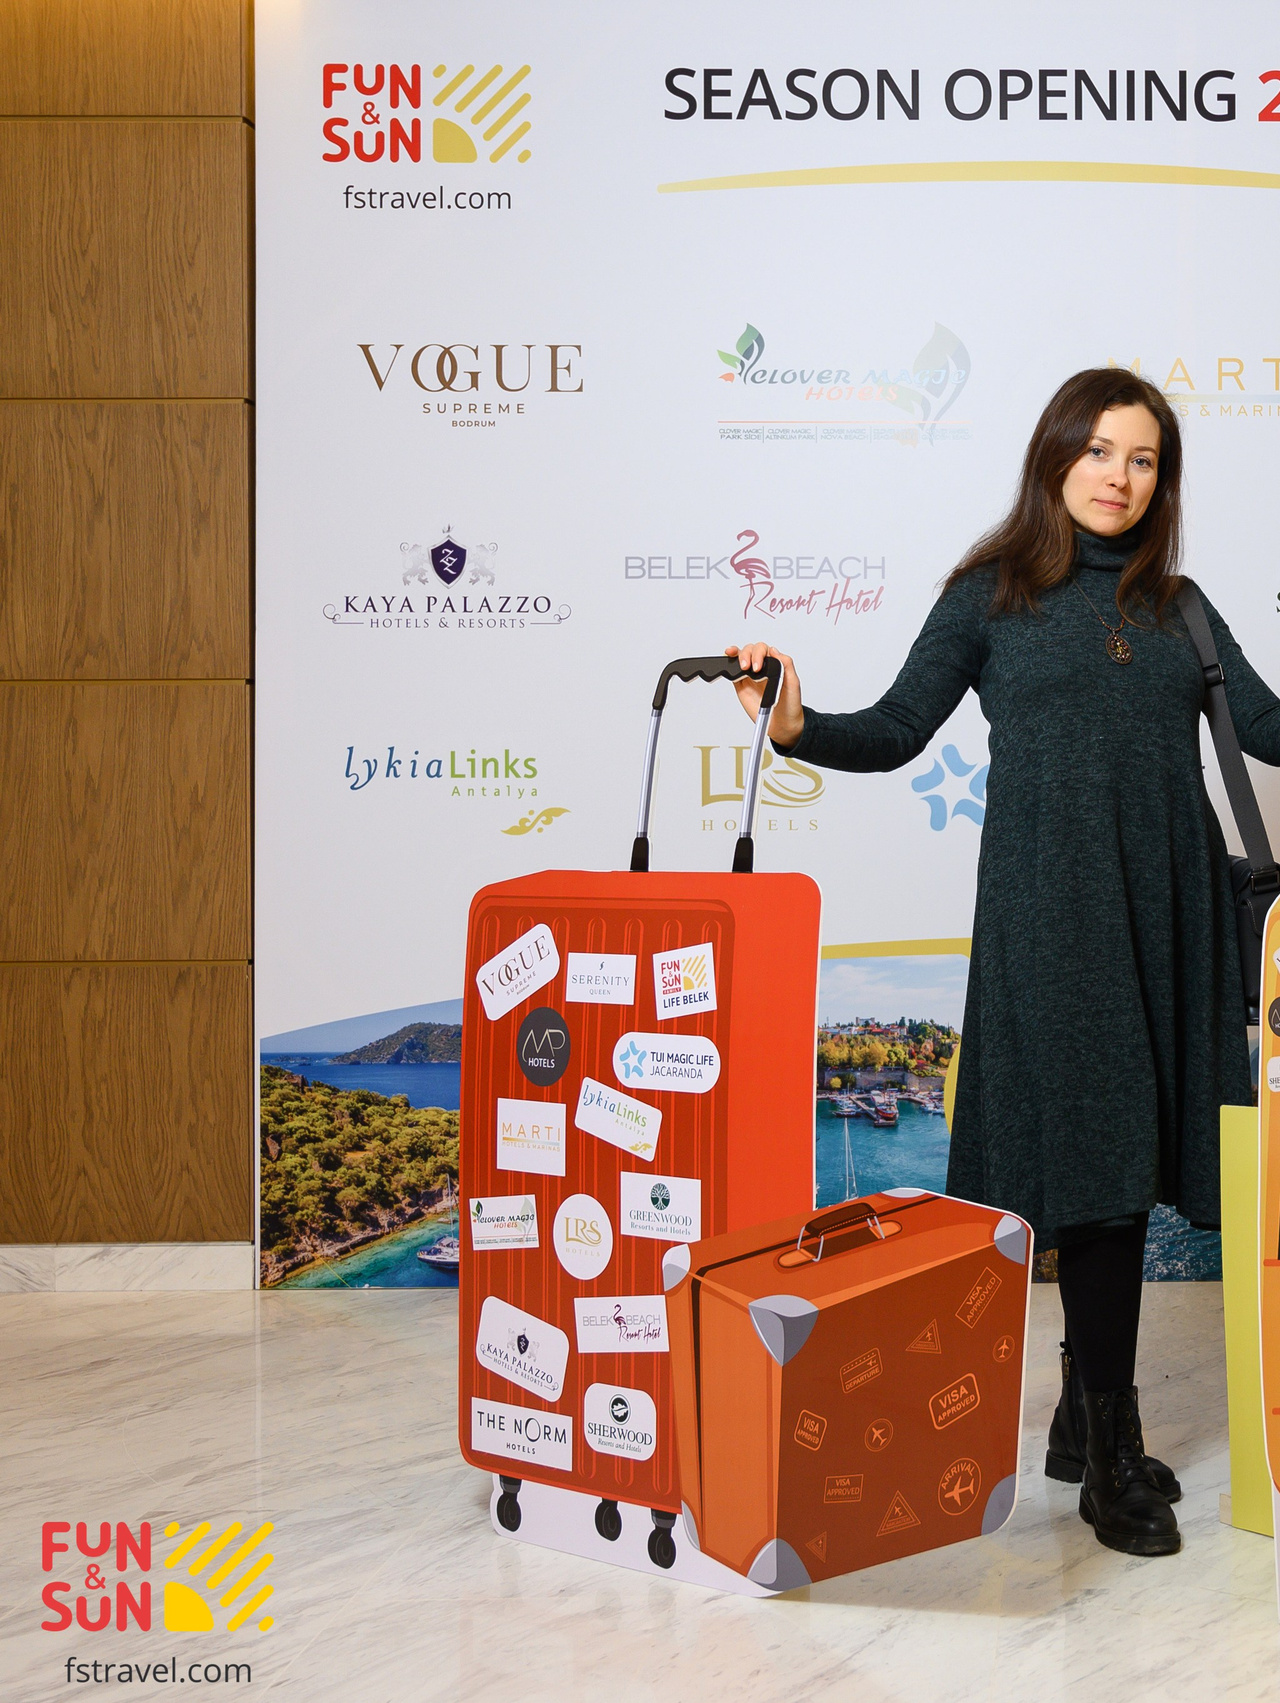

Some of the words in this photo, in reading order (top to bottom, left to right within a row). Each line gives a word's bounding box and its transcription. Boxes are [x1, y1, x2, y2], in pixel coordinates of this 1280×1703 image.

[322, 63, 421, 109] FUN
[664, 67, 919, 121] SEASON
[944, 68, 1236, 122] OPENING
[361, 101, 380, 125] &
[322, 117, 421, 163] SUN
[343, 185, 512, 209] fstravel.com
[356, 343, 584, 393] VOGUE
[422, 402, 526, 414] SUPREME
[1199, 404, 1211, 417] &
[452, 420, 496, 428] BODRUM
[624, 556, 730, 580] BELEK
[772, 556, 885, 580] BEACH
[344, 595, 415, 614] KAYA
[425, 595, 552, 614] PALAZZO
[738, 580, 826, 620] Resort
[825, 577, 885, 626] Hotel
[370, 618, 430, 629] HOTELS
[438, 618, 450, 629] &
[458, 618, 526, 629] RESORTS
[451, 785, 538, 799] Antalya
[701, 819, 819, 832] HOELS
[481, 935, 551, 996] VOGUE
[661, 960, 680, 975] FUN
[506, 970, 537, 997] SUPREME
[571, 974, 630, 987] SERENITY
[663, 996, 681, 1009] LIFE
[683, 991, 710, 1005] BELEK
[528, 1057, 555, 1069] HOTELS
[650, 1051, 665, 1063] TUI
[666, 1052, 694, 1065] MAGIC
[696, 1054, 714, 1066] LIFE
[650, 1065, 703, 1079] JACARANDA
[502, 1122, 561, 1142] MARTI
[629, 1209, 692, 1227] GREENWOOD
[630, 1221, 654, 1231] Resorts
[669, 1226, 691, 1236] Hotels
[966, 1286, 982, 1305] VISA
[966, 1277, 996, 1322] APPROVED
[582, 1315, 614, 1326] BELEK
[625, 1314, 660, 1325] BEACH
[487, 1343, 509, 1362] KAYA
[511, 1356, 553, 1384] PALAZZO
[845, 1367, 880, 1390] DEPARTURE
[939, 1385, 968, 1408] VISA
[938, 1394, 975, 1423] APPROVED
[477, 1411, 505, 1432] THE
[514, 1418, 567, 1444] NORM
[587, 1421, 653, 1446] SHERWOOD
[803, 1416, 819, 1434] VISA
[506, 1442, 536, 1455] HOTELS
[836, 1478, 850, 1487] VISA
[941, 1462, 975, 1490] ARRIVAL
[827, 1487, 860, 1496] APPROVED
